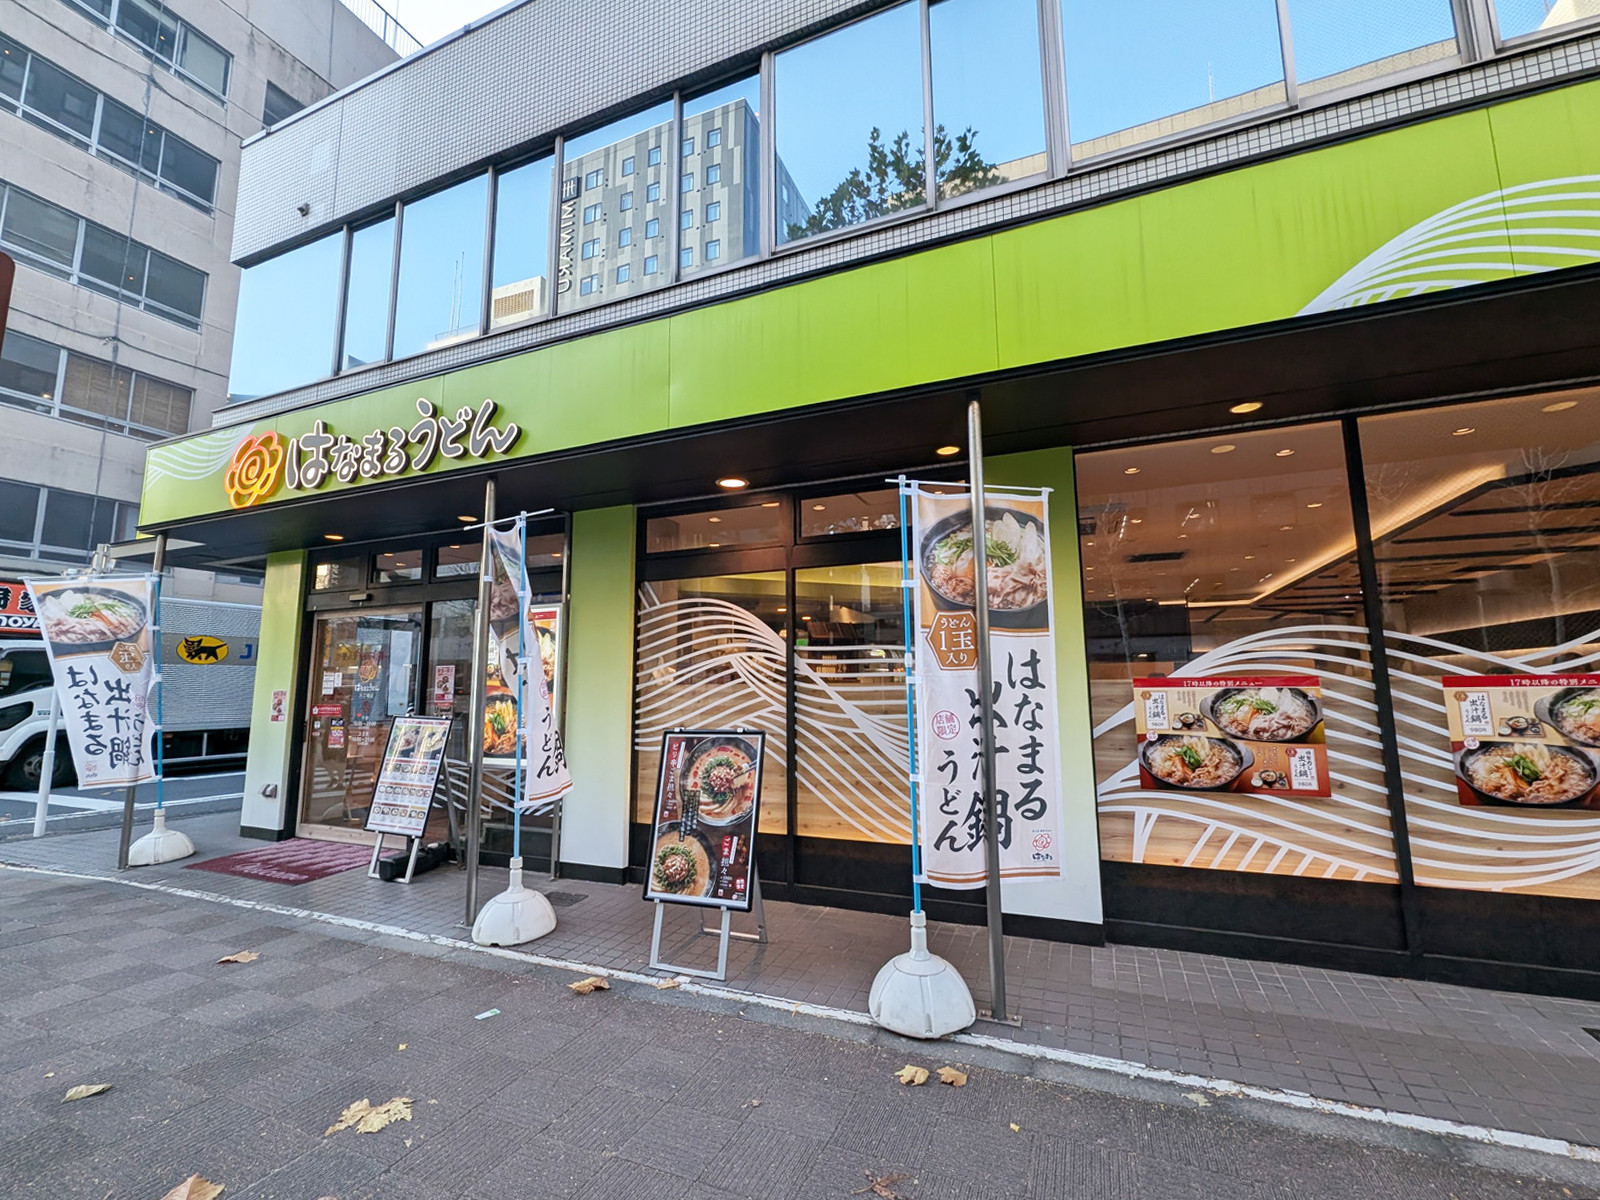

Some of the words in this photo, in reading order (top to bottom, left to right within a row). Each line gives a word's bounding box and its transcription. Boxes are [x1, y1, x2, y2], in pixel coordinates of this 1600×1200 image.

[285, 397, 520, 490] はなまるうどん
[940, 616, 971, 628] うどん
[945, 652, 968, 665] 入り
[537, 707, 554, 779] うどん
[1007, 648, 1048, 821] はなまる
[933, 750, 969, 853] うどん
